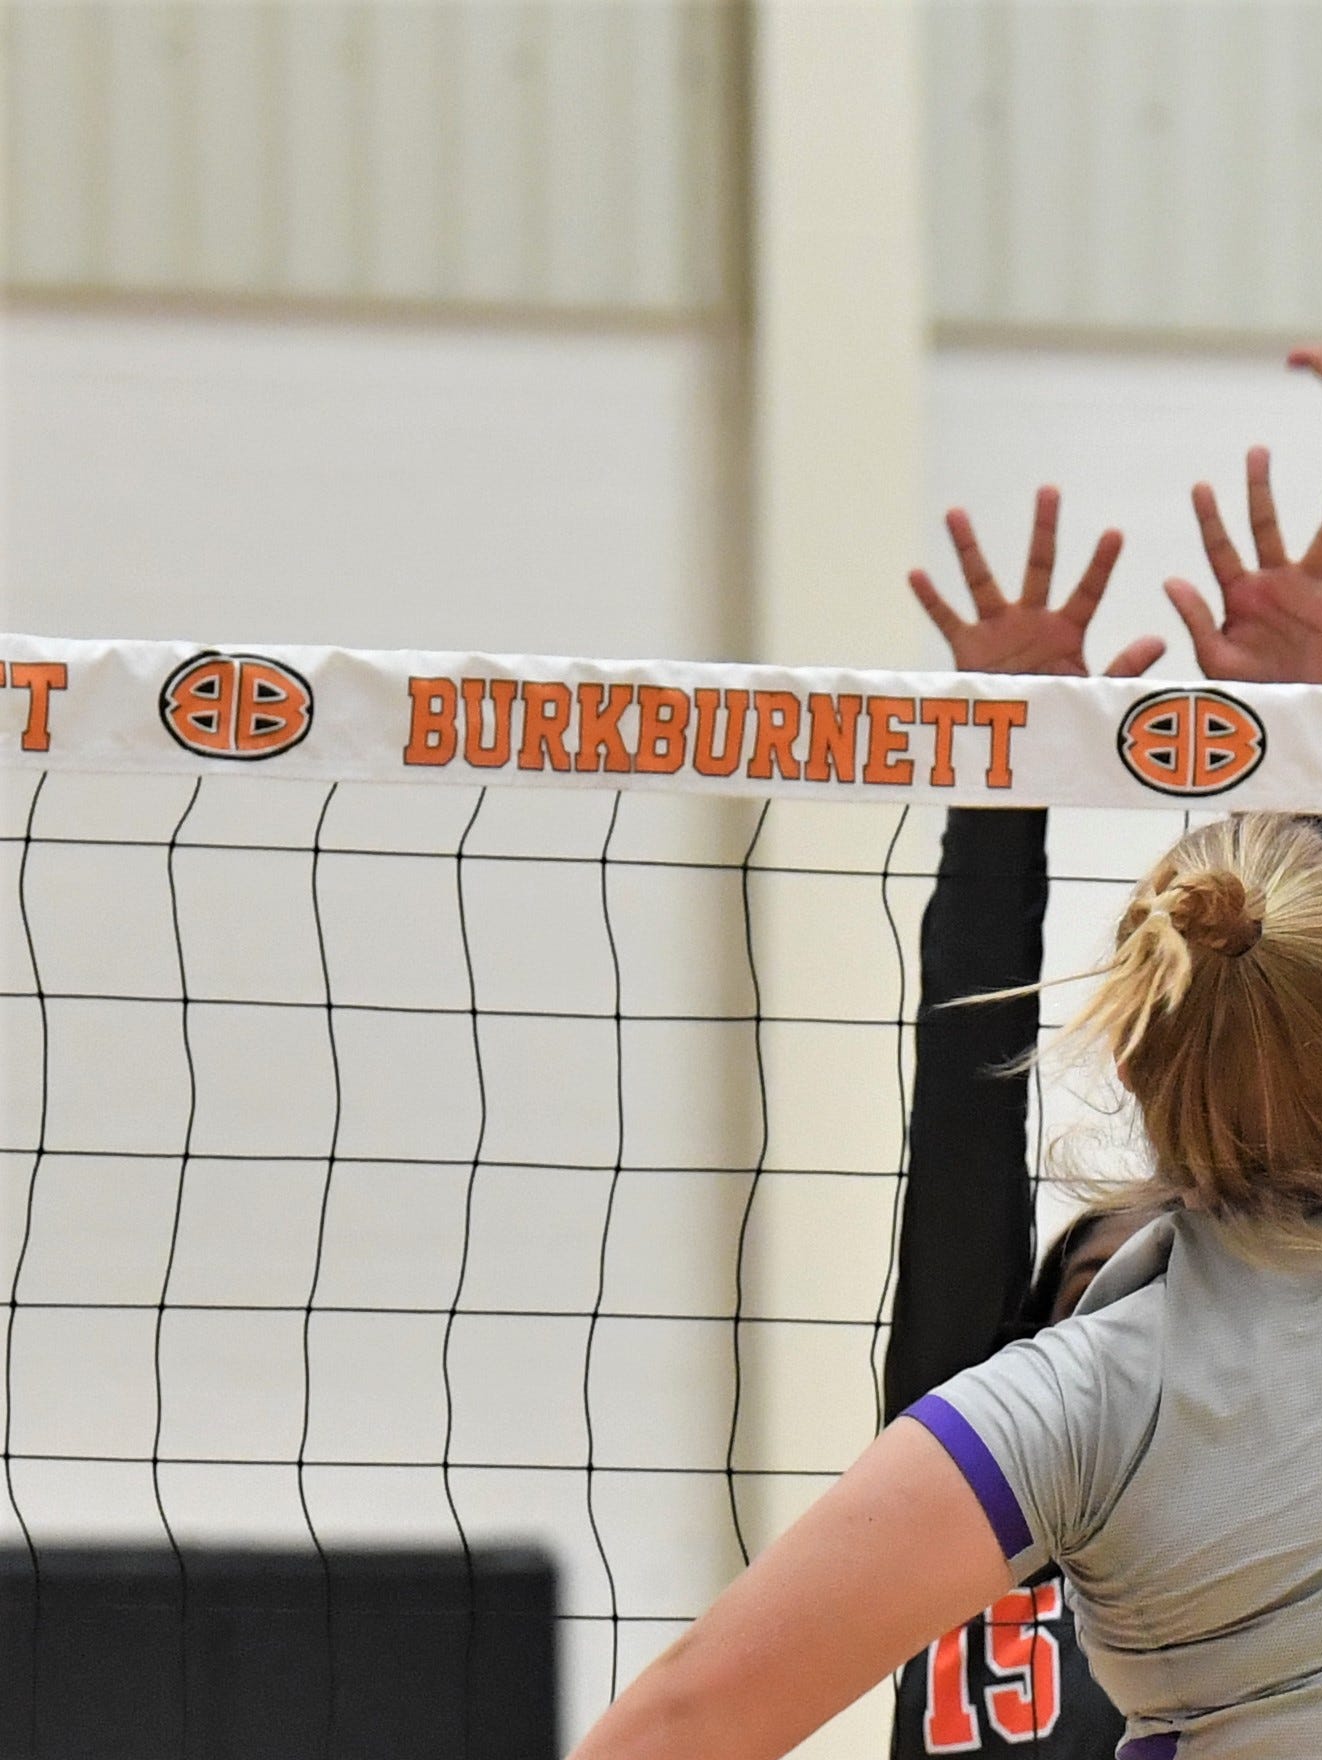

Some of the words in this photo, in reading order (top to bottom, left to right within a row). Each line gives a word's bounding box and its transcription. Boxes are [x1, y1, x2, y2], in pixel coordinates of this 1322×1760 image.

[0, 660, 68, 752] T
[404, 676, 1029, 789] BURKBURNETT
[924, 1577, 1063, 1755] 15
